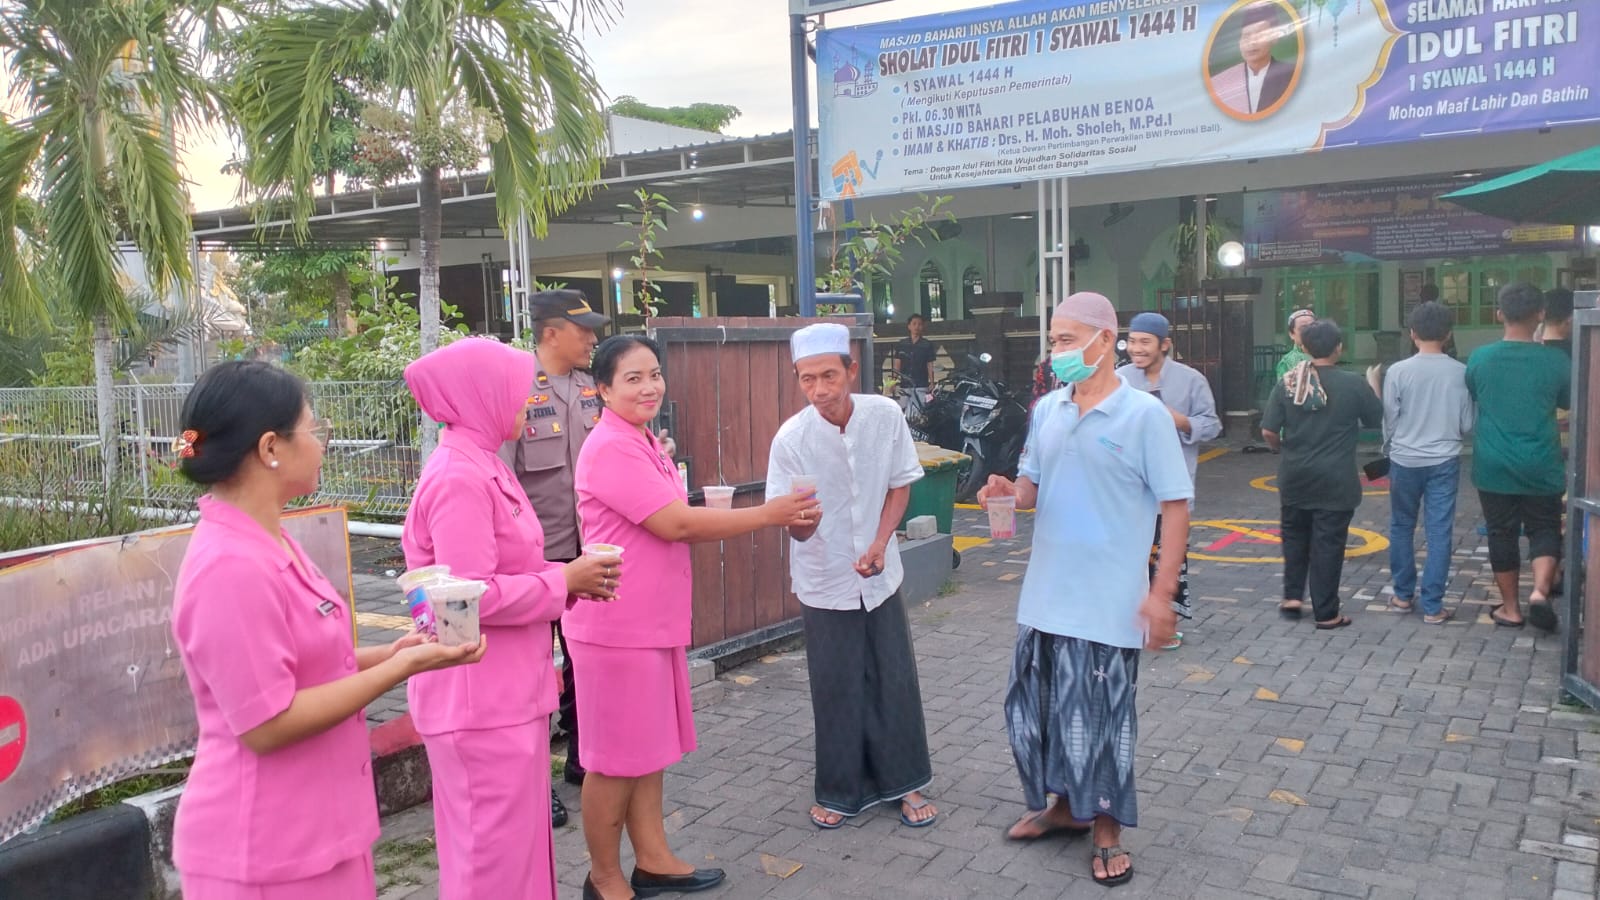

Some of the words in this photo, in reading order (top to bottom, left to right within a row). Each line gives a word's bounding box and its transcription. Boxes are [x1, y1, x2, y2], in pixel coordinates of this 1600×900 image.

[880, 34, 921, 49] MASJID
[924, 26, 966, 43] BAHARI
[970, 20, 1005, 36] INSYA
[1008, 12, 1046, 30] ALLAH
[1050, 6, 1086, 22] AKAN
[1407, 0, 1485, 24] SELAMAT
[878, 45, 938, 76] SHOLAT
[941, 40, 980, 68] IDUL
[986, 31, 1030, 60] FITRI
[1036, 30, 1044, 54] 1
[1050, 17, 1121, 51] SYAWAL
[1128, 8, 1176, 39] 1444
[1182, 5, 1198, 31] H
[1408, 26, 1482, 64] IDUL
[1494, 12, 1578, 51] FITRI
[904, 82, 909, 94] 1
[914, 74, 964, 93] SYAWAL
[969, 69, 1000, 84] 1444
[1004, 66, 1014, 78] H
[954, 84, 1006, 100] Keputusan
[1009, 74, 1072, 91] Pemerintah)
[1409, 74, 1416, 92] 1
[1422, 64, 1488, 90] SYAWAL
[1494, 58, 1536, 81] 1444
[1542, 56, 1556, 76] H
[903, 128, 913, 142] di
[916, 122, 964, 140] MASJID
[968, 116, 1014, 134] BAHARI
[1018, 104, 1100, 127] PELABUHAN
[1104, 97, 1154, 116] BENOA
[925, 106, 954, 122] 06.30
[956, 104, 982, 118] WITA
[1389, 106, 1432, 121] Mohon
[1436, 99, 1469, 116] Maaf
[1472, 95, 1506, 111] Lahir
[1510, 92, 1538, 108] Dan
[1542, 86, 1589, 104] Bathin
[904, 141, 933, 157] IMAM
[936, 140, 944, 154] &
[948, 136, 989, 152] KHATIB
[998, 133, 1022, 146] Drs.
[1026, 130, 1038, 143] H.
[1042, 127, 1072, 141] Moh.
[1077, 120, 1125, 136] Sholeh,
[1130, 113, 1172, 131] M.Pd.I
[1164, 127, 1198, 137] Provinsi
[930, 164, 960, 175] Dengan
[962, 162, 978, 170] Idul
[980, 160, 996, 168] Fitri
[998, 158, 1013, 166] Kita
[1016, 154, 1056, 165] Wujudkan
[1059, 150, 1106, 160] Solidaritas
[1108, 146, 1137, 155] Sosial
[930, 173, 952, 182] Untuk
[1014, 165, 1036, 173] Umat
[1038, 162, 1054, 171] dan
[1056, 160, 1089, 169] Bangsa
[18, 637, 57, 670] ADA
[64, 606, 173, 649] UPACARA
